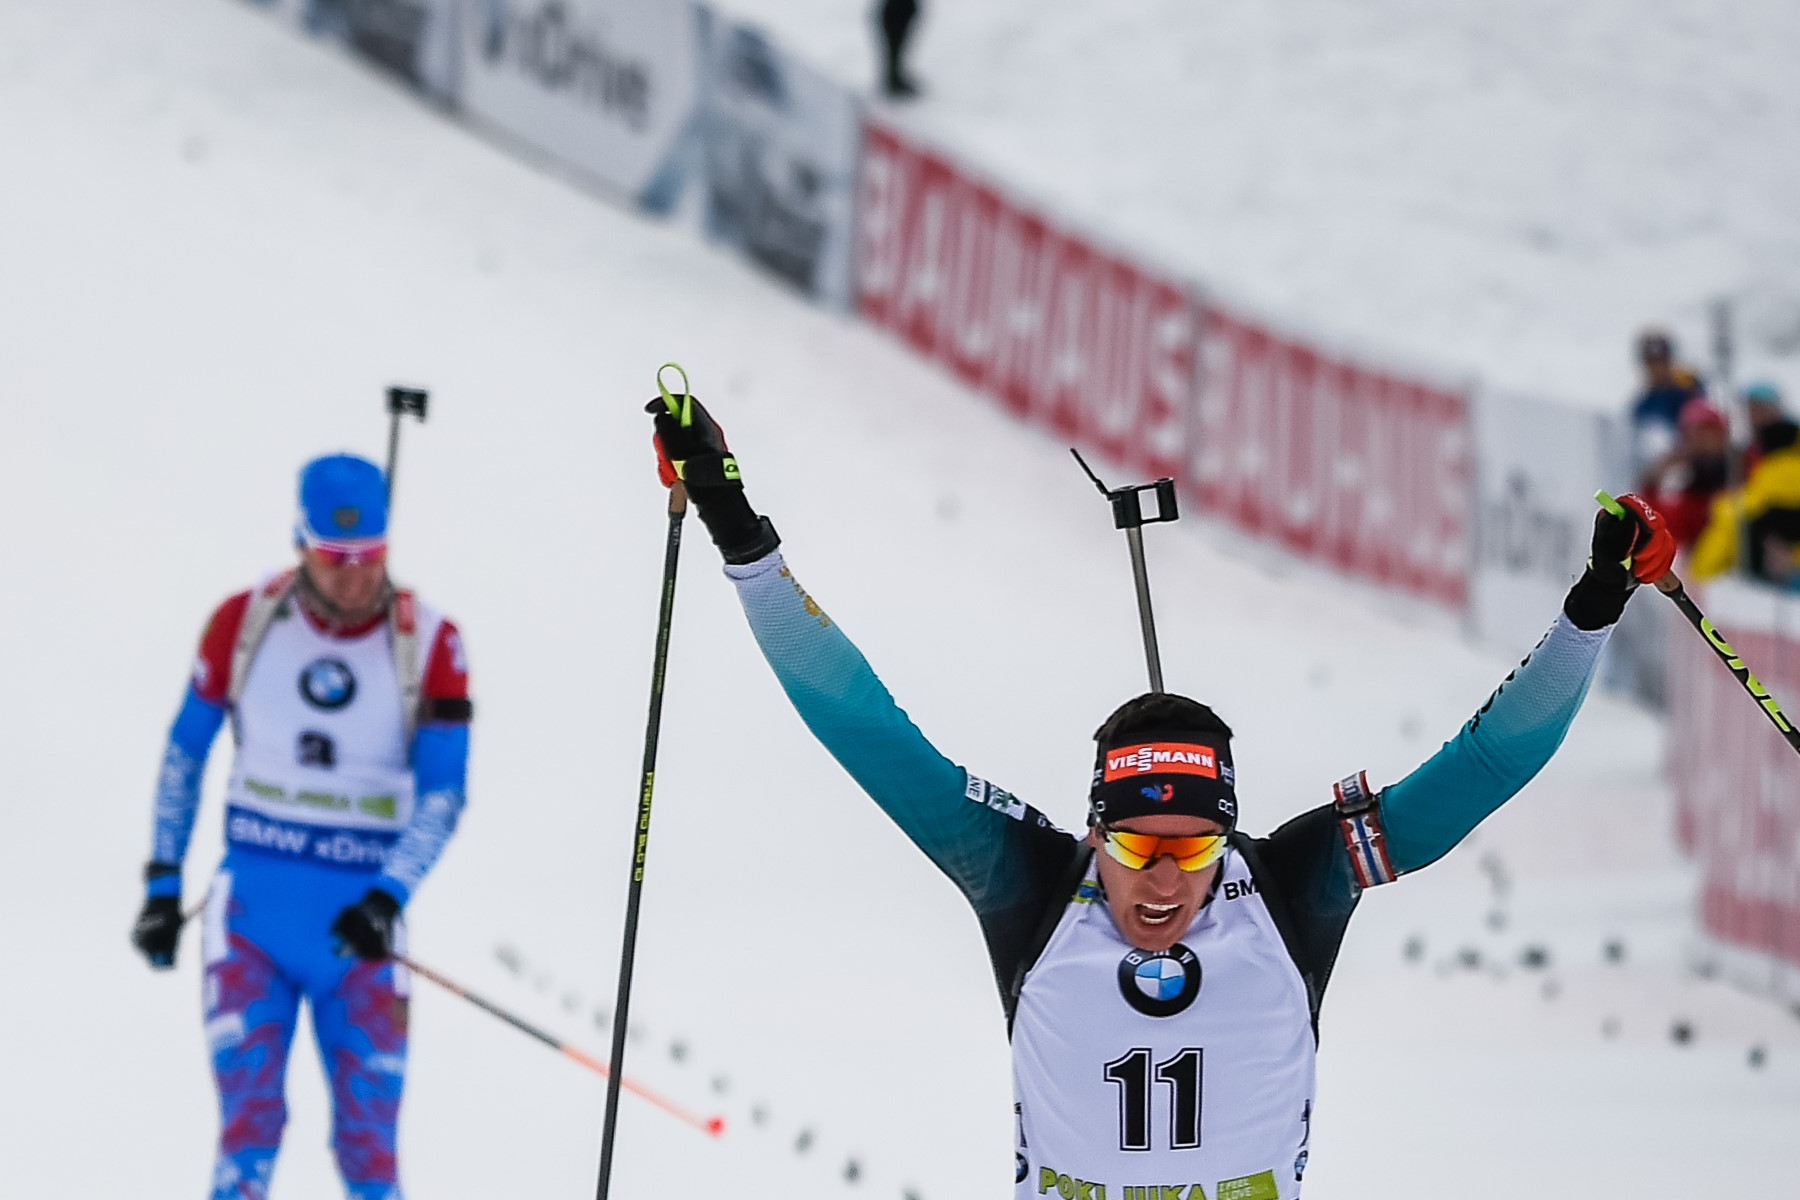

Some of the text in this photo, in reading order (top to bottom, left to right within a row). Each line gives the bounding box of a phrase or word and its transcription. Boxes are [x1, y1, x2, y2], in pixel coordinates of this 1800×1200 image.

[858, 148, 1188, 462] BAUHAUS
[1108, 747, 1213, 772] VIESSMANN
[1103, 1047, 1204, 1152] 11
